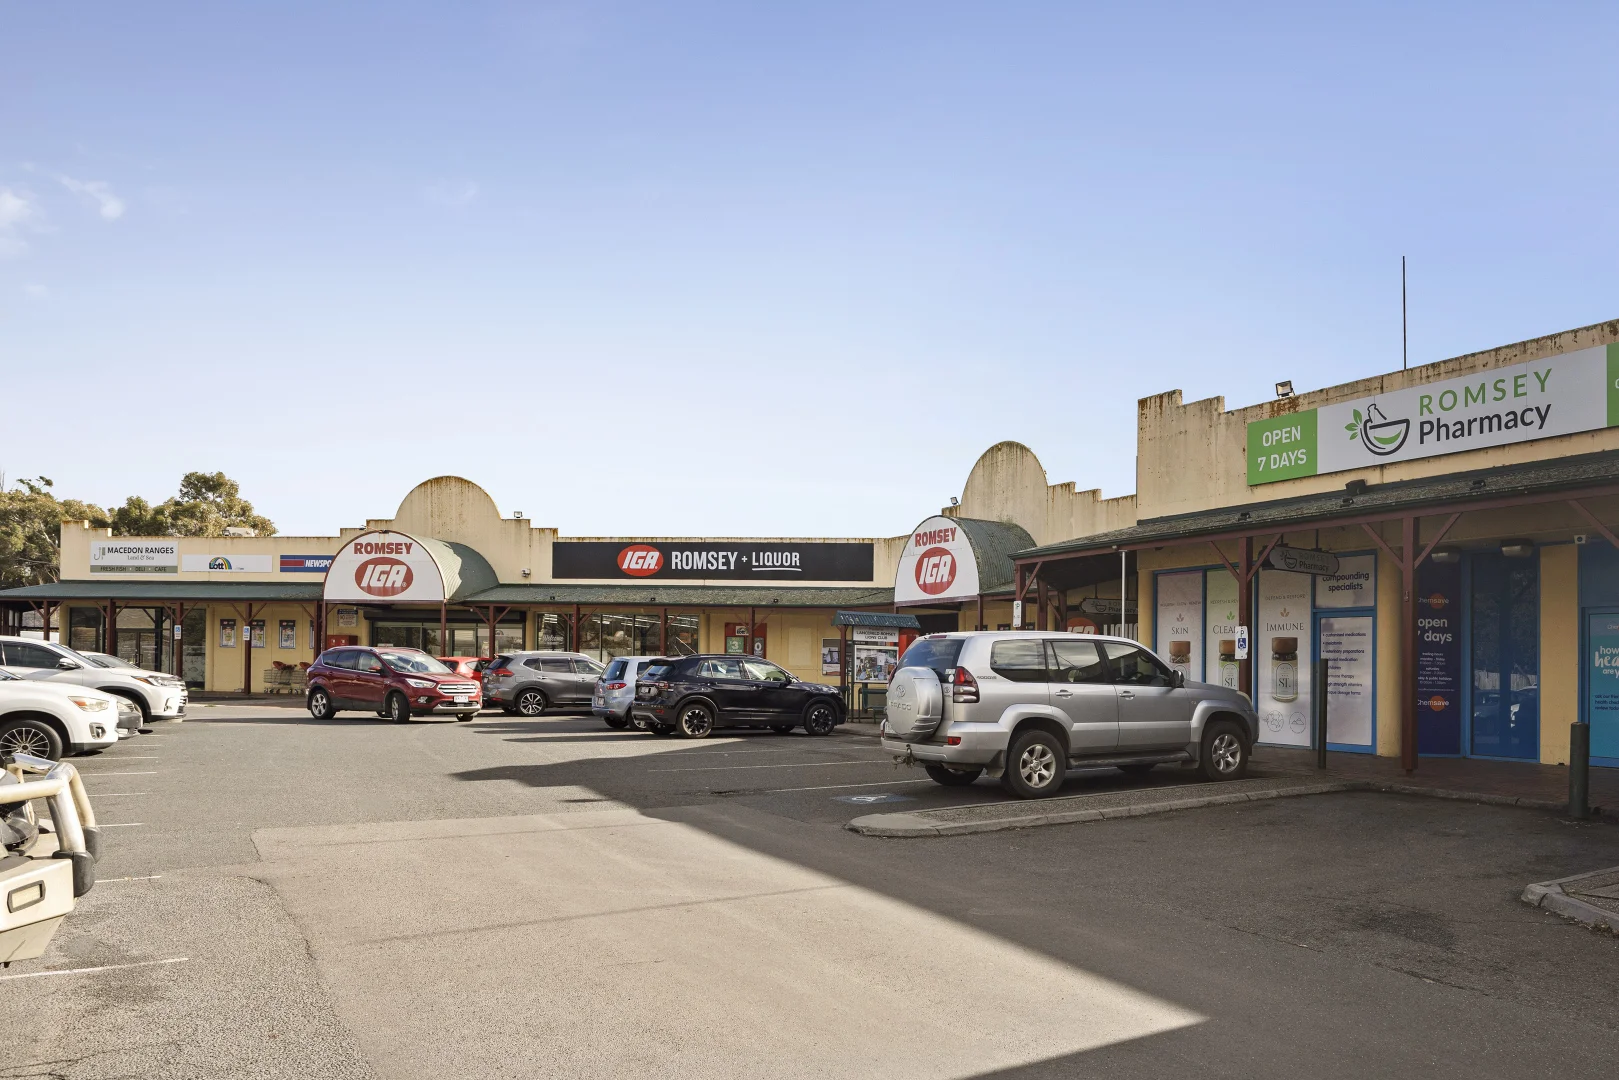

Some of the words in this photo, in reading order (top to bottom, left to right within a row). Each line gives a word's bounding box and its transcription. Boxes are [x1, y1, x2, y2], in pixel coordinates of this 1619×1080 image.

[1420, 368, 1552, 416] ROMSEY
[1420, 404, 1552, 444] Pharmacy
[1262, 426, 1300, 446] OPEN
[1258, 457, 1266, 472] 7
[1270, 449, 1306, 470] DAYS
[915, 527, 957, 548] ROMSEY
[354, 542, 413, 554] ROMSEY
[622, 551, 660, 570] IGA
[672, 551, 738, 570] ROMSEY
[752, 552, 800, 566] LIQUOR
[919, 554, 953, 584] IGA
[1299, 560, 1330, 572] Pharmacy
[360, 564, 408, 587] IGA
[1328, 582, 1363, 593] specialists
[1171, 627, 1188, 635] SKIN
[1212, 625, 1235, 634] CLEA
[1266, 622, 1304, 632] IMMUNE
[1418, 618, 1448, 629] open
[1424, 630, 1452, 644] days
